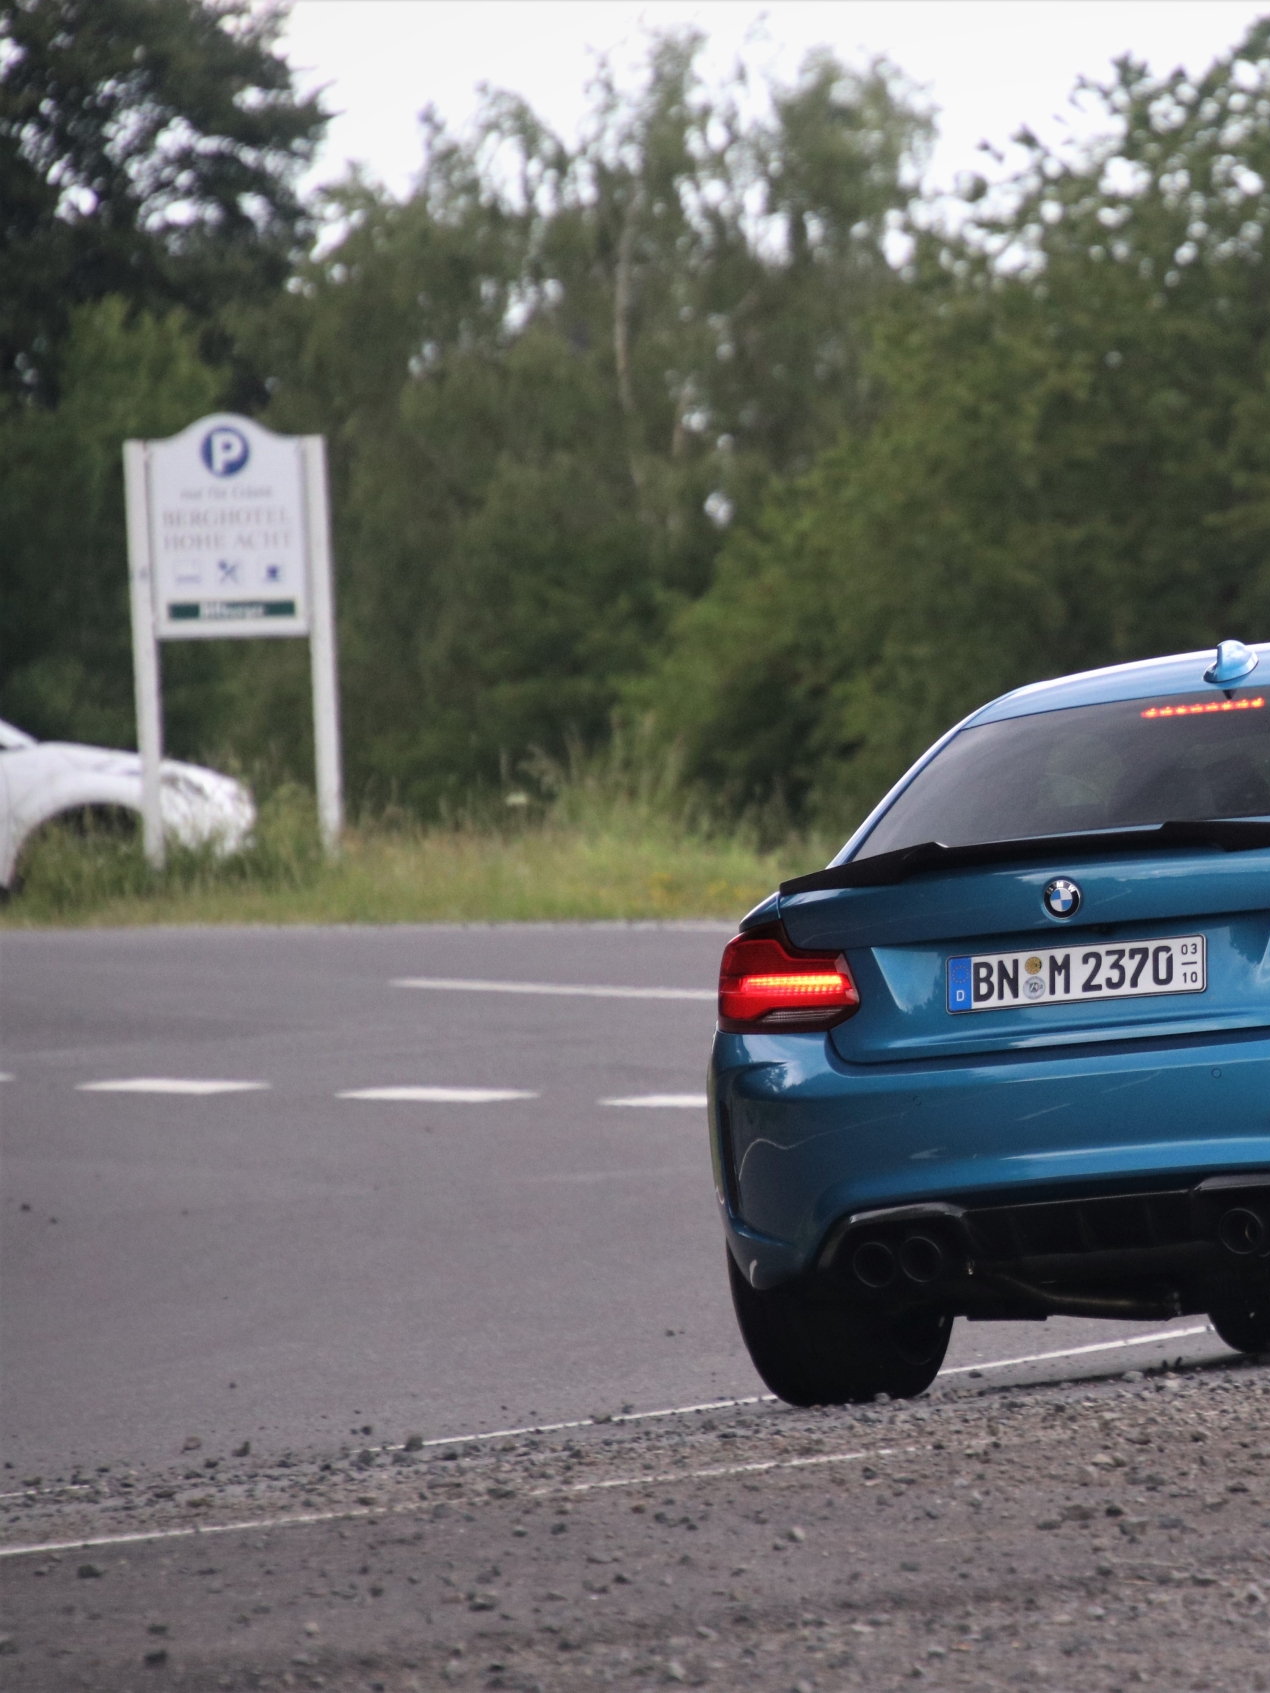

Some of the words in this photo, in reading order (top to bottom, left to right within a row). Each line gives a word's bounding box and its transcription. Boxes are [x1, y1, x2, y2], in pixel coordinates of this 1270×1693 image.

[210, 430, 245, 476] P
[1181, 943, 1198, 956] 03
[956, 989, 965, 1001] D
[972, 958, 1020, 1002] BN
[1049, 953, 1071, 996] M
[1081, 945, 1174, 993] 2370
[1182, 971, 1198, 984] 10
